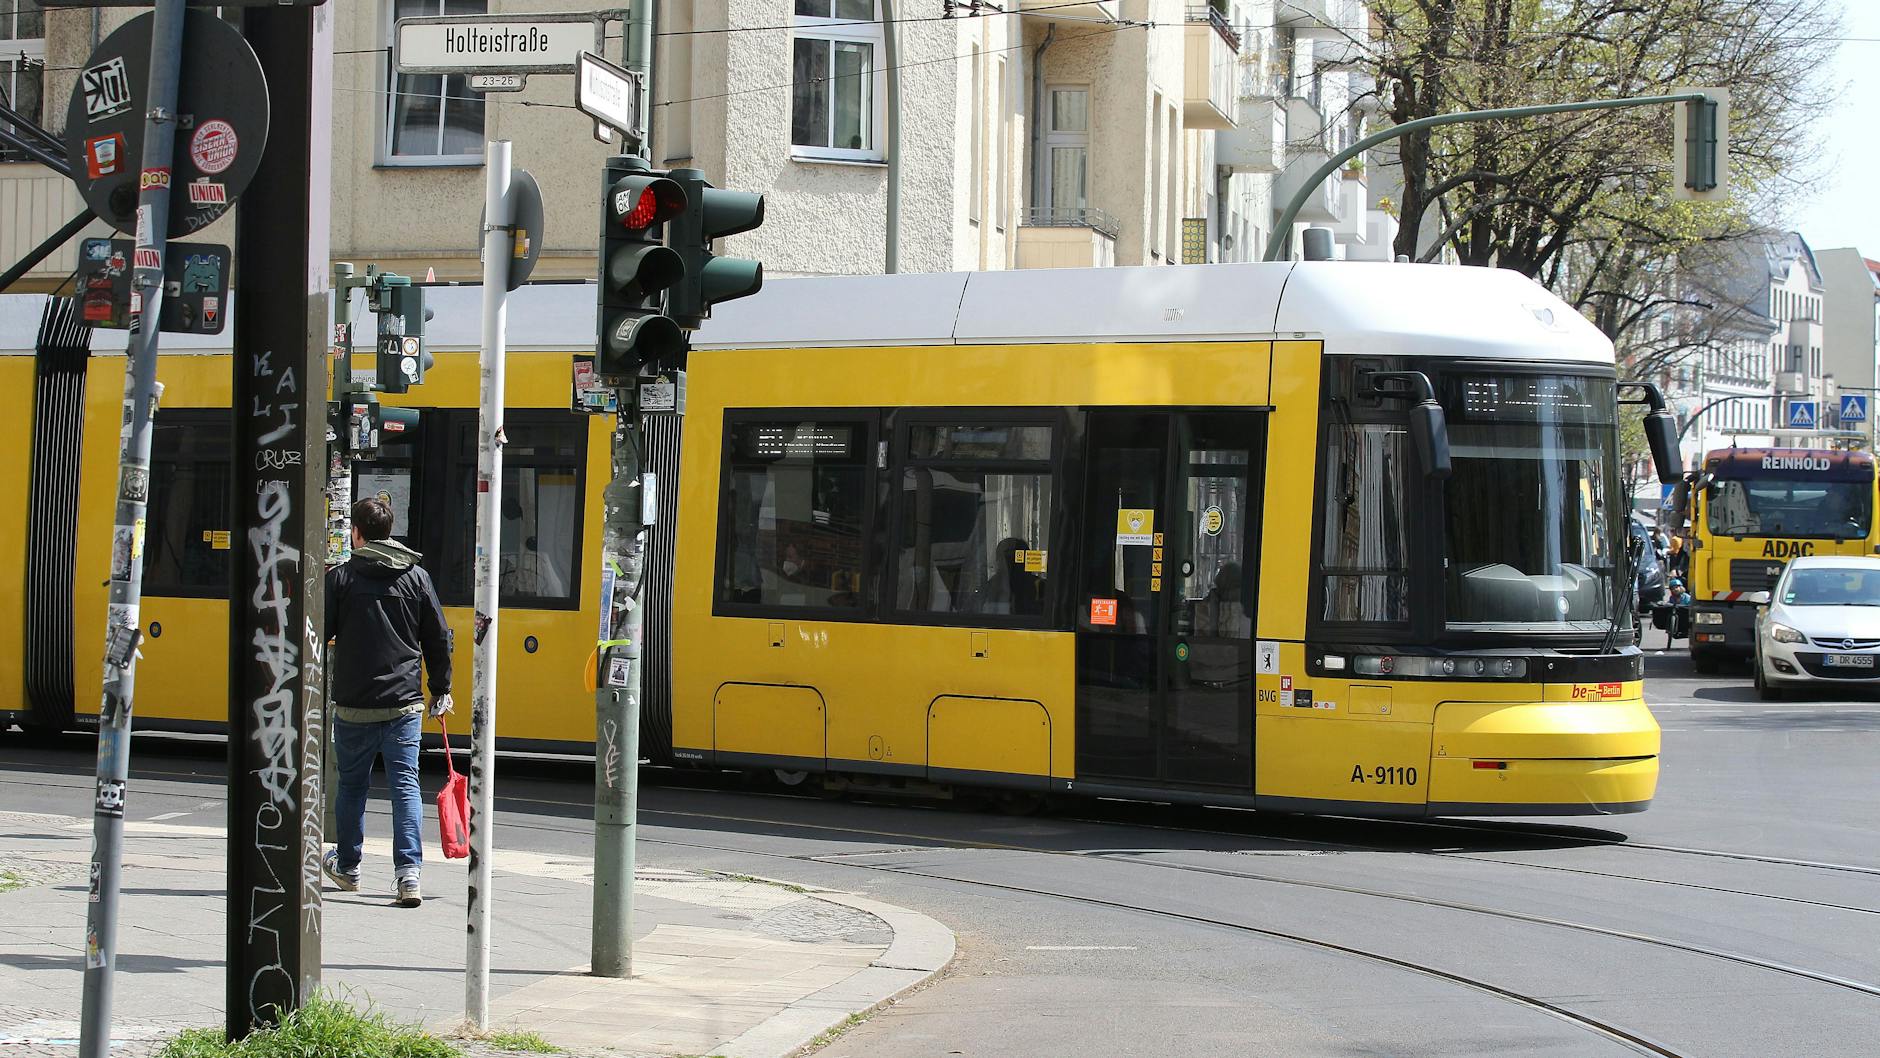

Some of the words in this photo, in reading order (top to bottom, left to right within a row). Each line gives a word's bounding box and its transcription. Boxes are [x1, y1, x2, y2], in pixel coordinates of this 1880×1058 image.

[446, 27, 548, 53] Holteistraße
[482, 76, 514, 86] 23-26
[190, 184, 225, 203] UNION
[134, 249, 161, 269] NION
[1762, 456, 1831, 471] REINHOLD
[1762, 540, 1814, 557] ADAC
[1259, 689, 1277, 702] BVG
[1572, 684, 1587, 698] be
[1603, 685, 1620, 695] Berlin
[1350, 764, 1417, 786] A-9110
